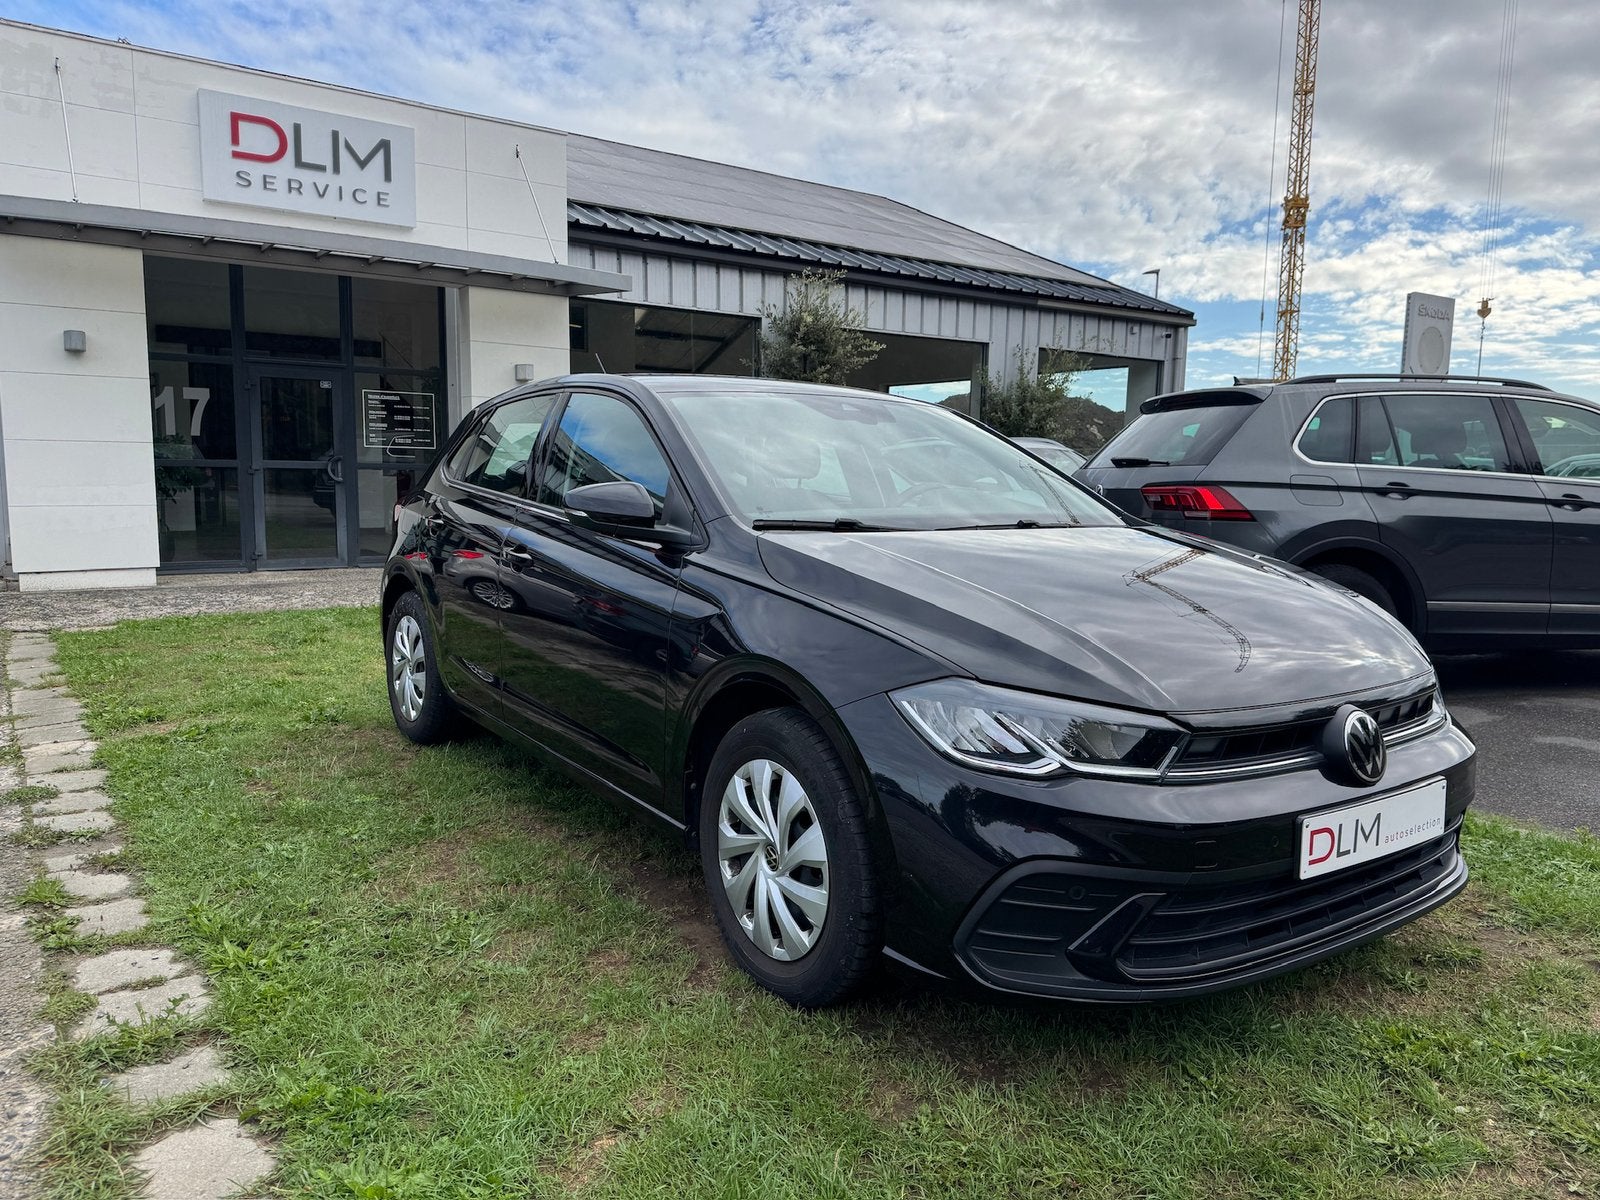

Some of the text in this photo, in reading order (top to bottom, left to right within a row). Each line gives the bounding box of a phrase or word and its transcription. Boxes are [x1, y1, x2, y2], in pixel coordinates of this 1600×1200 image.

[230, 111, 392, 183] DLM
[236, 170, 391, 208] SERVICE
[154, 386, 210, 437] 17
[1308, 812, 1441, 866] DLM autoselection
